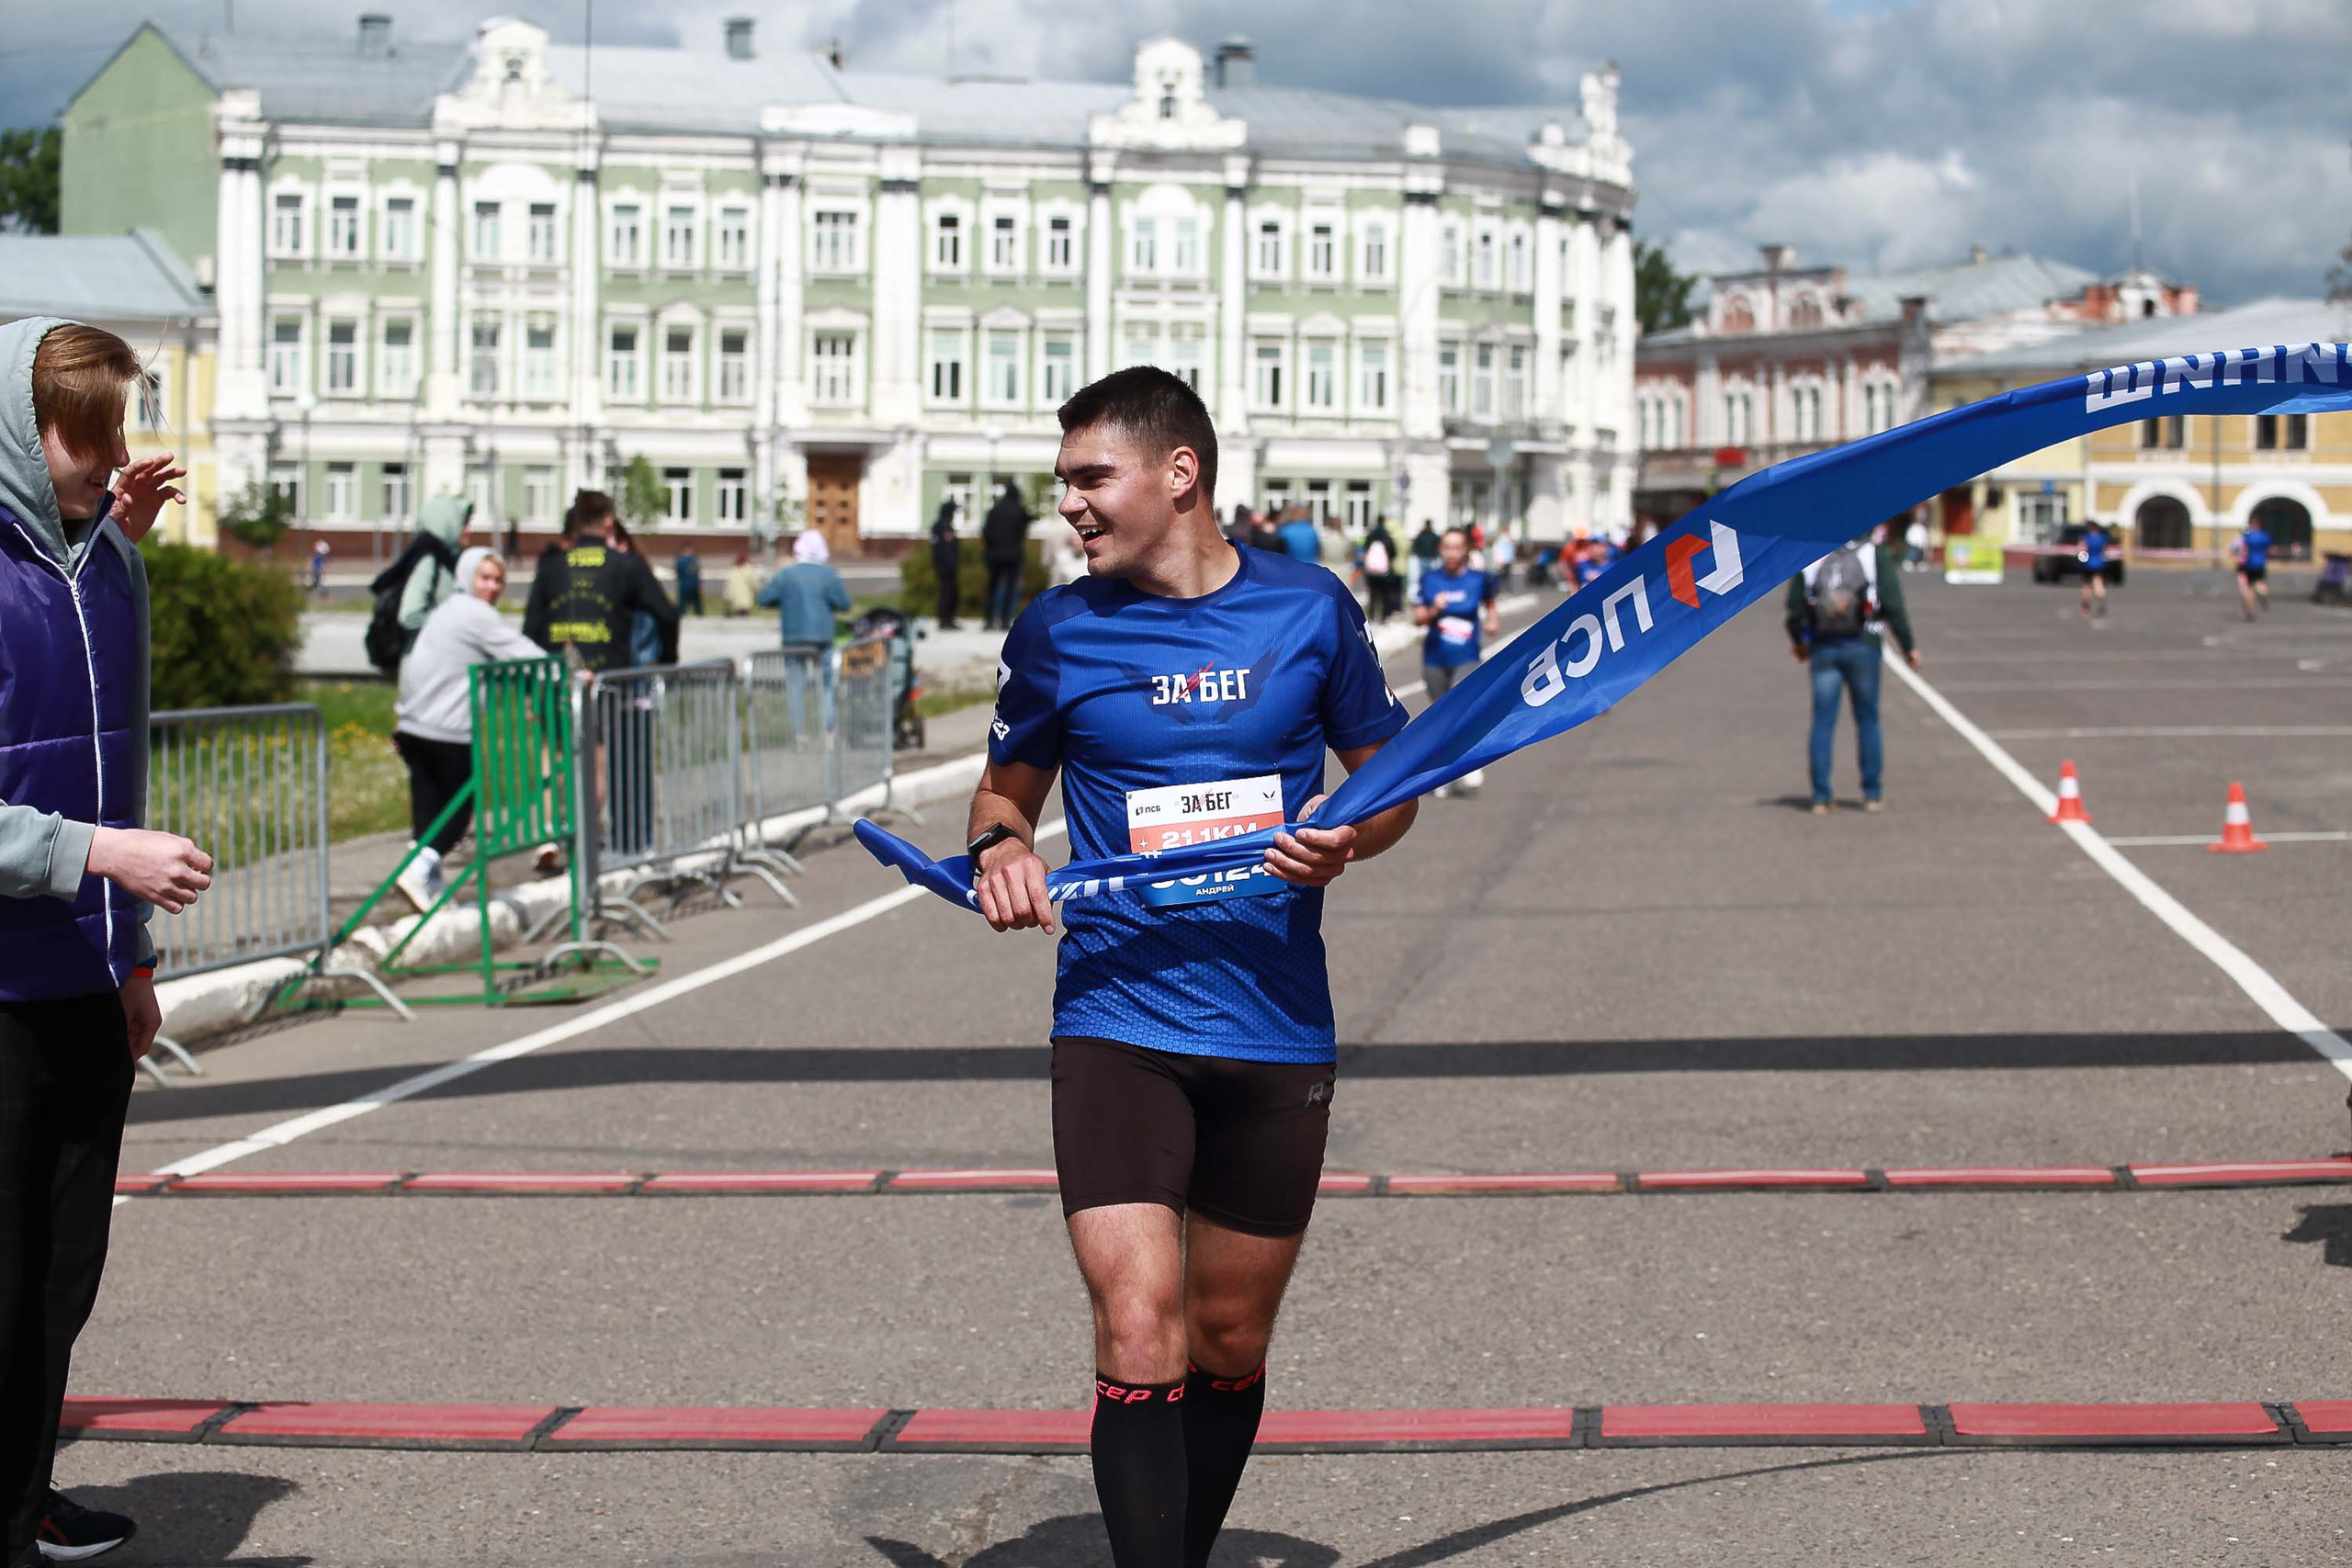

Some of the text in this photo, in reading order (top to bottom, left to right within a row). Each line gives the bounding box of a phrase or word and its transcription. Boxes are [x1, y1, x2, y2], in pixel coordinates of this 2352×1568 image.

[1145, 805, 1161, 814] ПСБ
[1195, 884, 1235, 896] АНДРЕЙ
[1097, 1381, 1152, 1404] cep
